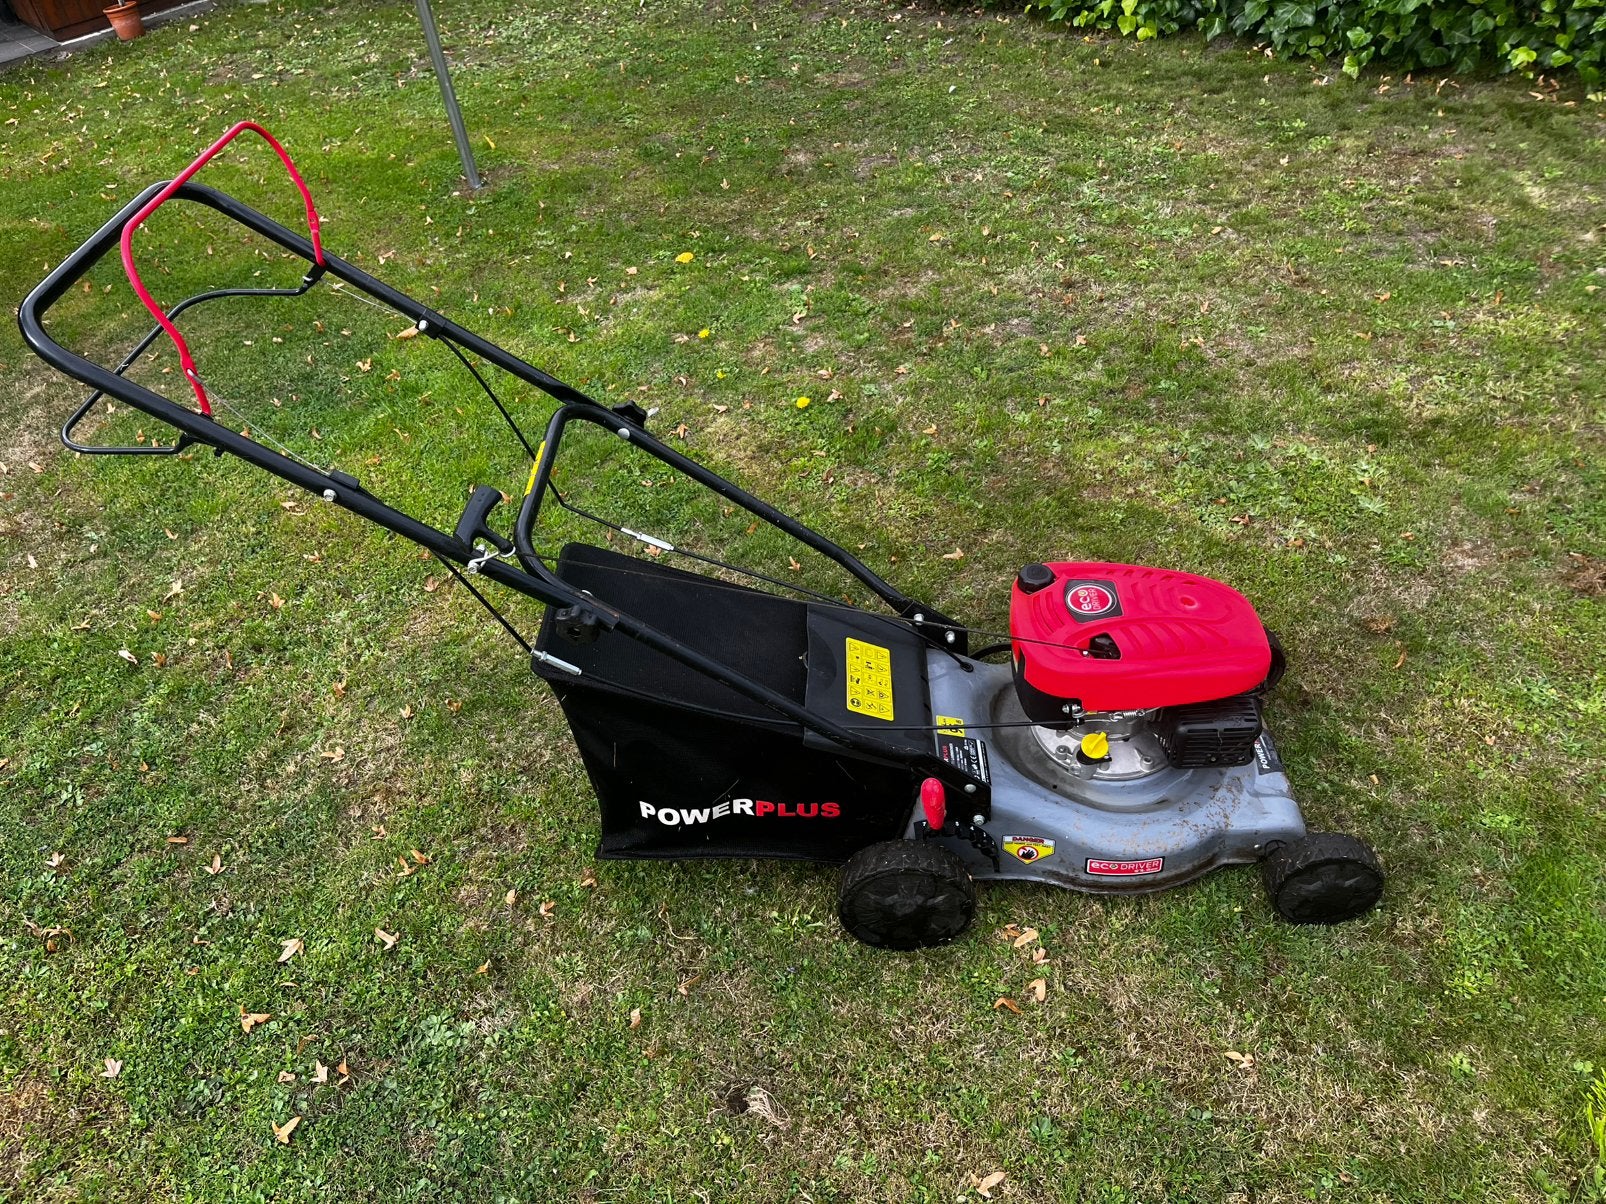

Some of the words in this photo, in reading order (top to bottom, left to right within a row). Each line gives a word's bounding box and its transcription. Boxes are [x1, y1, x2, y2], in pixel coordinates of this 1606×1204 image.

[1077, 589, 1092, 611] eco
[1088, 588, 1102, 611] DRIVER
[638, 798, 842, 826] POWERPLUS
[1012, 836, 1044, 844] DANGER
[1091, 861, 1119, 870] eco
[1120, 860, 1160, 870] DRIVER
